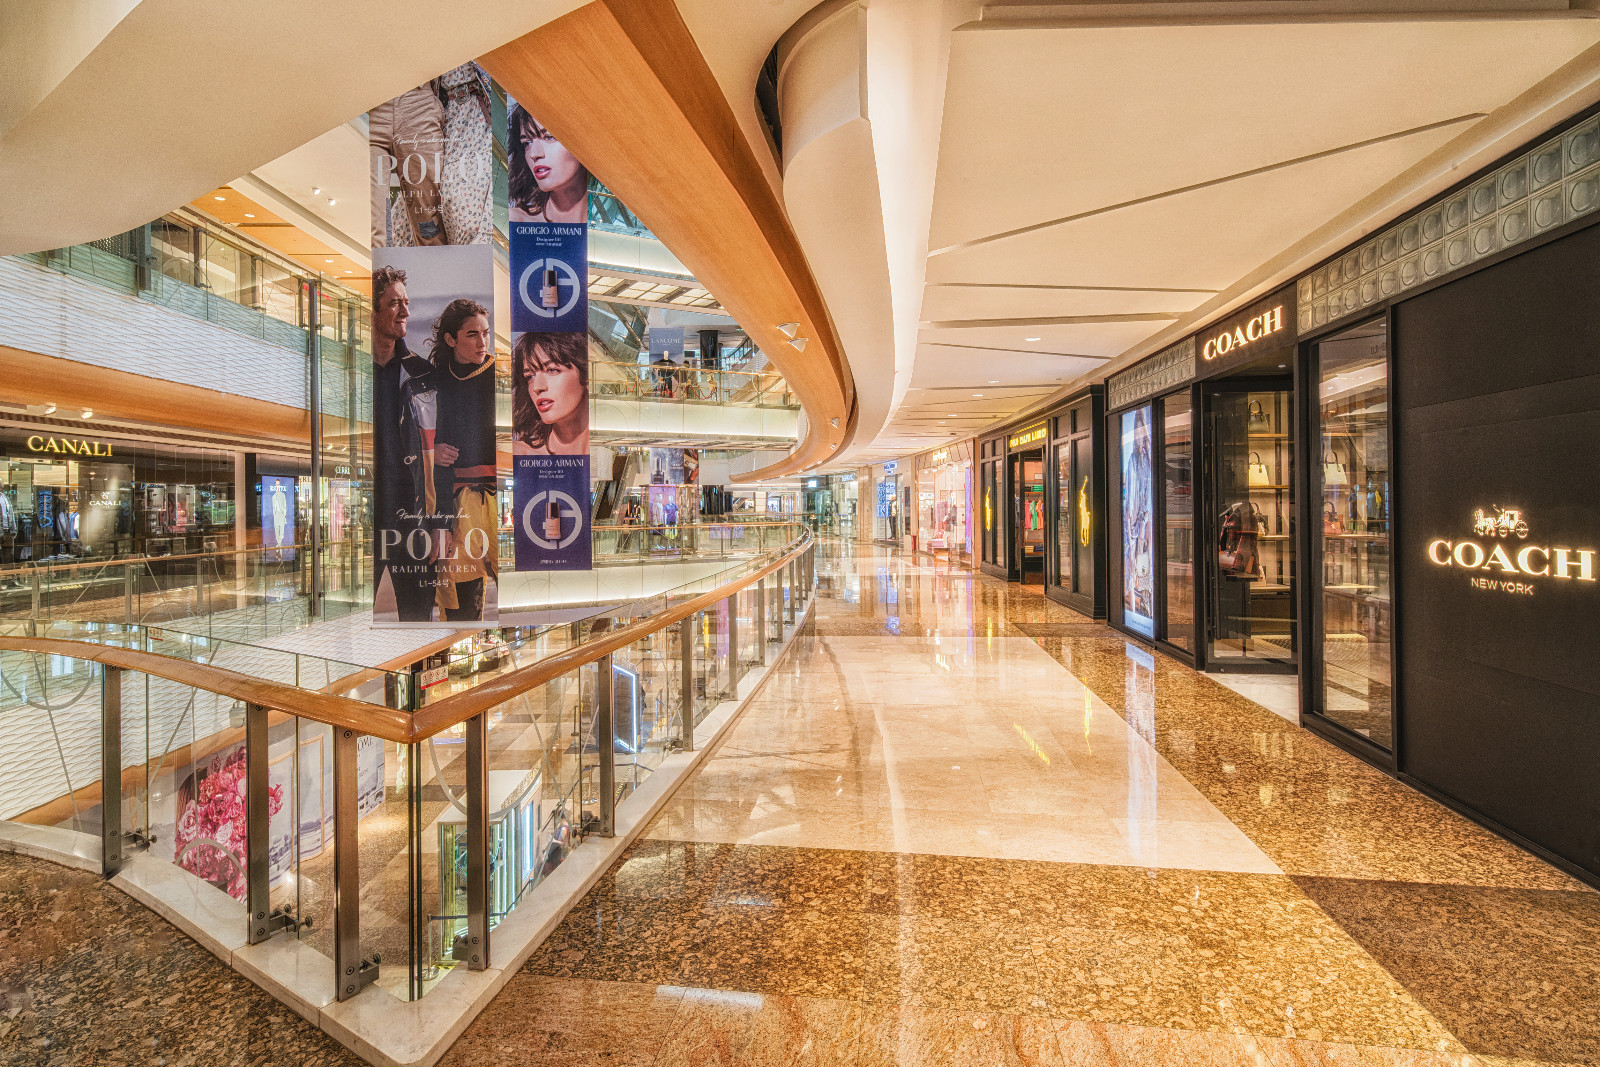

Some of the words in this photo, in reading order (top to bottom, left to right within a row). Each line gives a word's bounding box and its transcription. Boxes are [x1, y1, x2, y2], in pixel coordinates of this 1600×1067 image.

[376, 151, 484, 186] POLO
[516, 226, 550, 235] GIORGIO
[551, 227, 582, 236] ARMANI
[1202, 304, 1283, 361] COACH
[27, 435, 113, 457] CANALI
[519, 459, 553, 468] GIORGIO
[554, 459, 584, 467] ARMANI
[380, 528, 489, 560] POLO
[392, 565, 428, 573] RALPH
[434, 564, 477, 573] LAUREN
[1428, 540, 1596, 582] COACH
[1471, 577, 1498, 591] NEW
[1499, 581, 1534, 596] YORK
